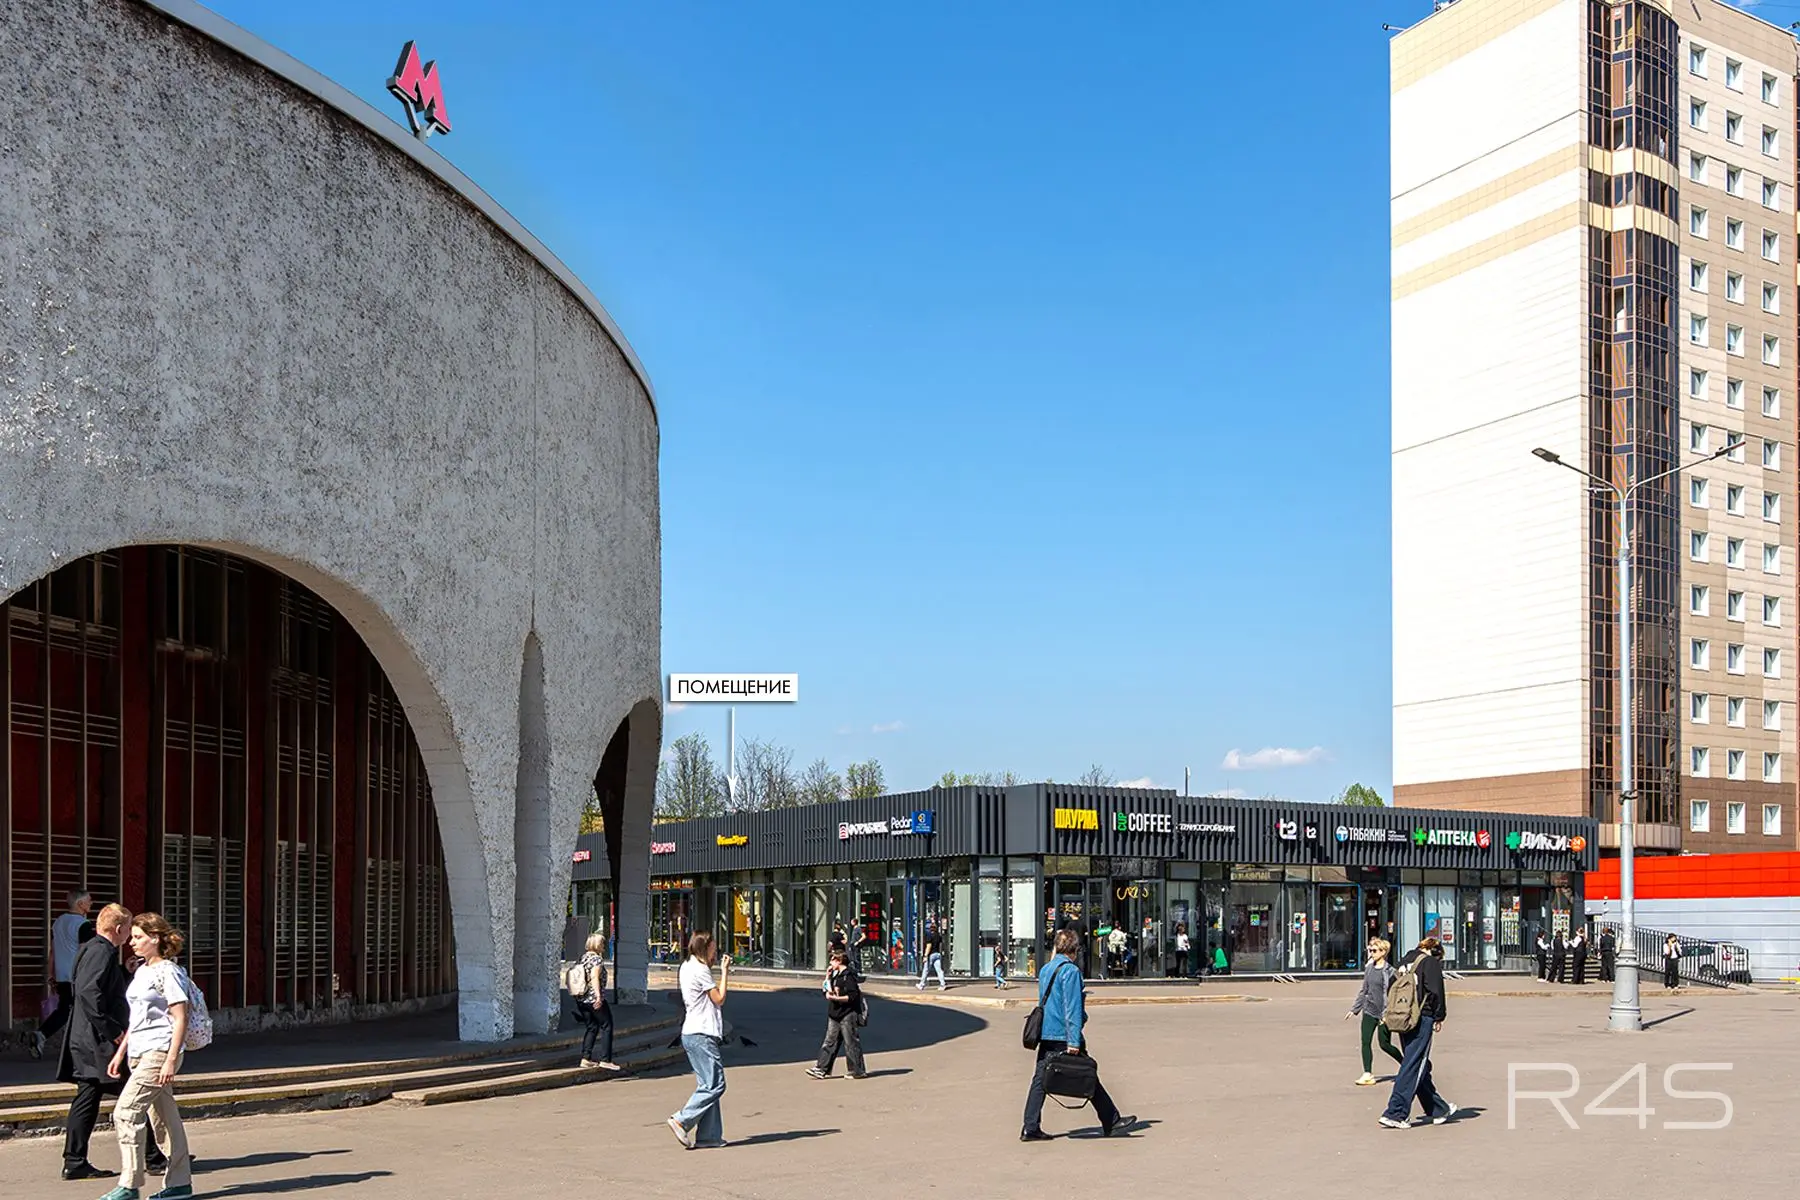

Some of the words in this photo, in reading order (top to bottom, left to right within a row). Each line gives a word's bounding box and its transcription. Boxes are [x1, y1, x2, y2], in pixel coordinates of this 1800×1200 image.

[1054, 808, 1099, 830] ШАУРМА
[1117, 811, 1128, 832] CUP
[1128, 812, 1172, 833] COFFEE
[1279, 818, 1297, 840] t2
[1306, 826, 1317, 839] t2
[1348, 826, 1386, 842] ТАБАКИН
[1427, 829, 1478, 846] АПТЕКА
